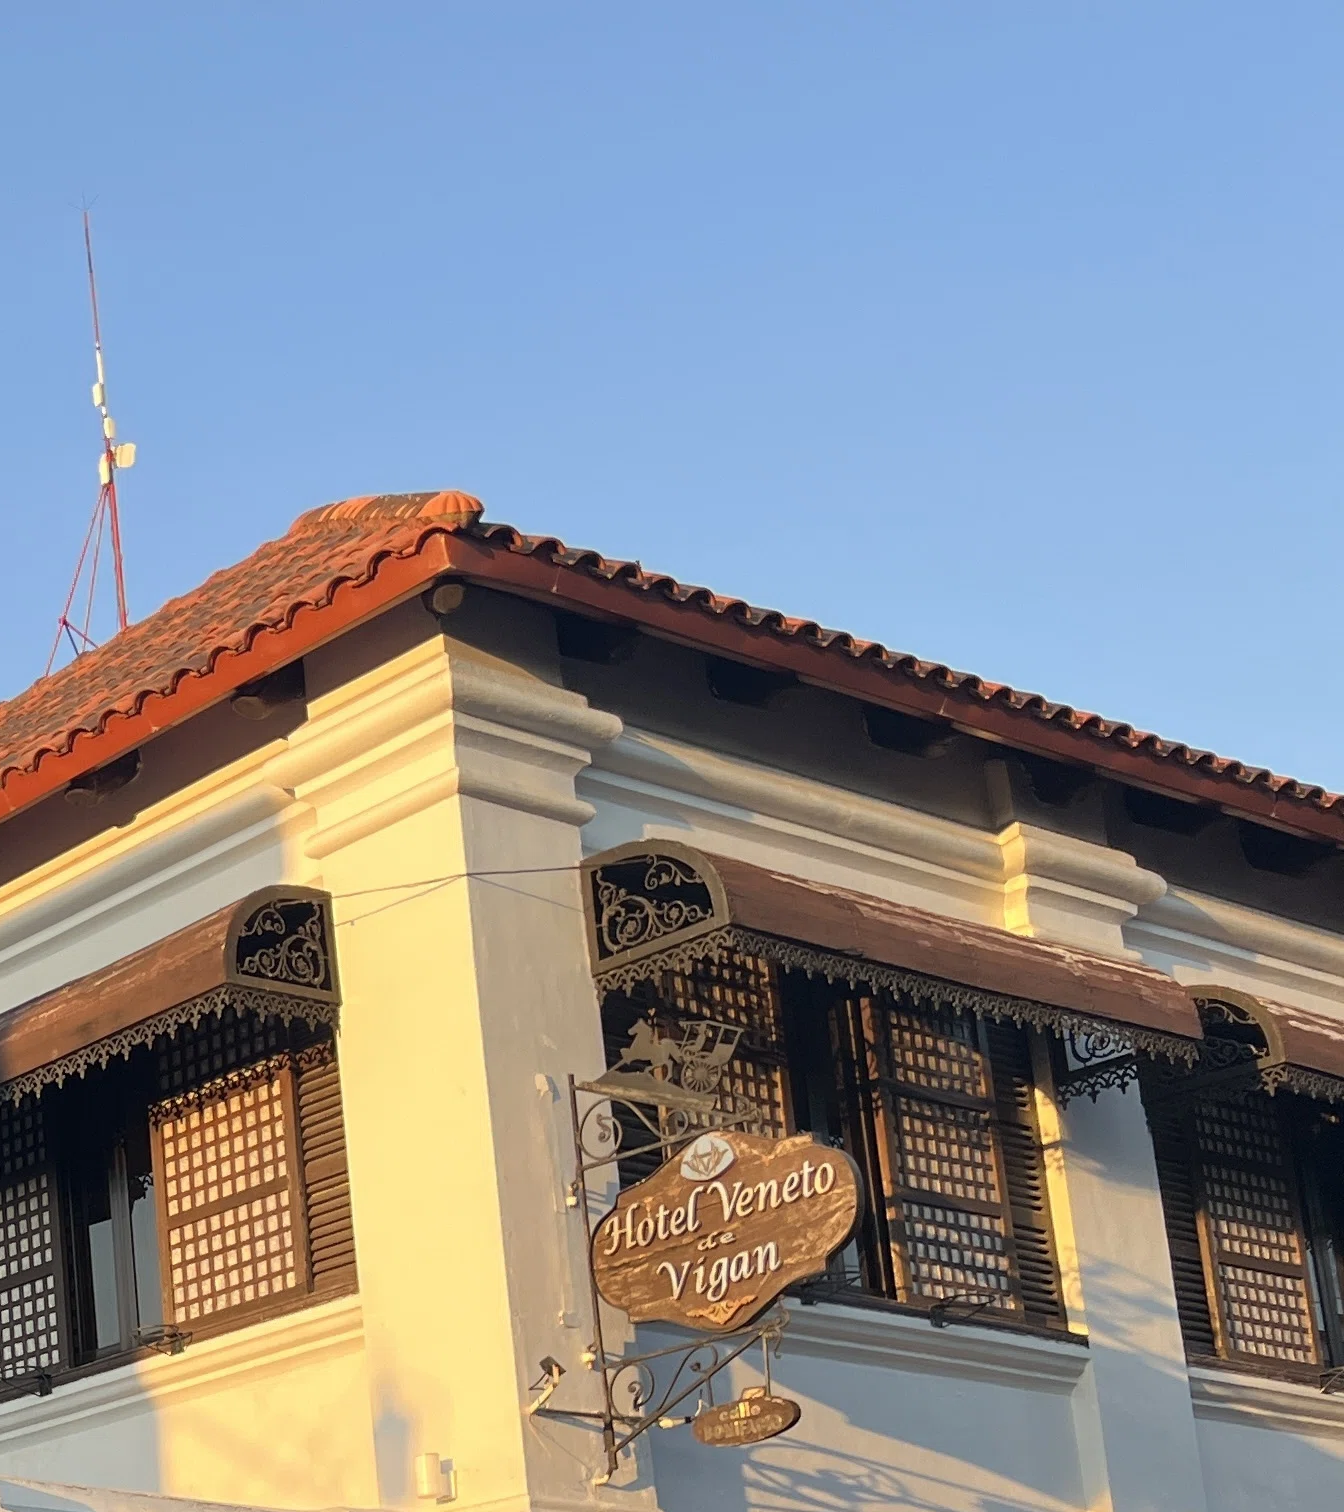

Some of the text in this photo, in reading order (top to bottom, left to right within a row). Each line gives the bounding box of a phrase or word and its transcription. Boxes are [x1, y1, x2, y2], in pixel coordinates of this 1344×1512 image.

[603, 1160, 835, 1256] Hotel Veneto
[697, 1230, 736, 1251] de
[656, 1241, 783, 1302] Vigan
